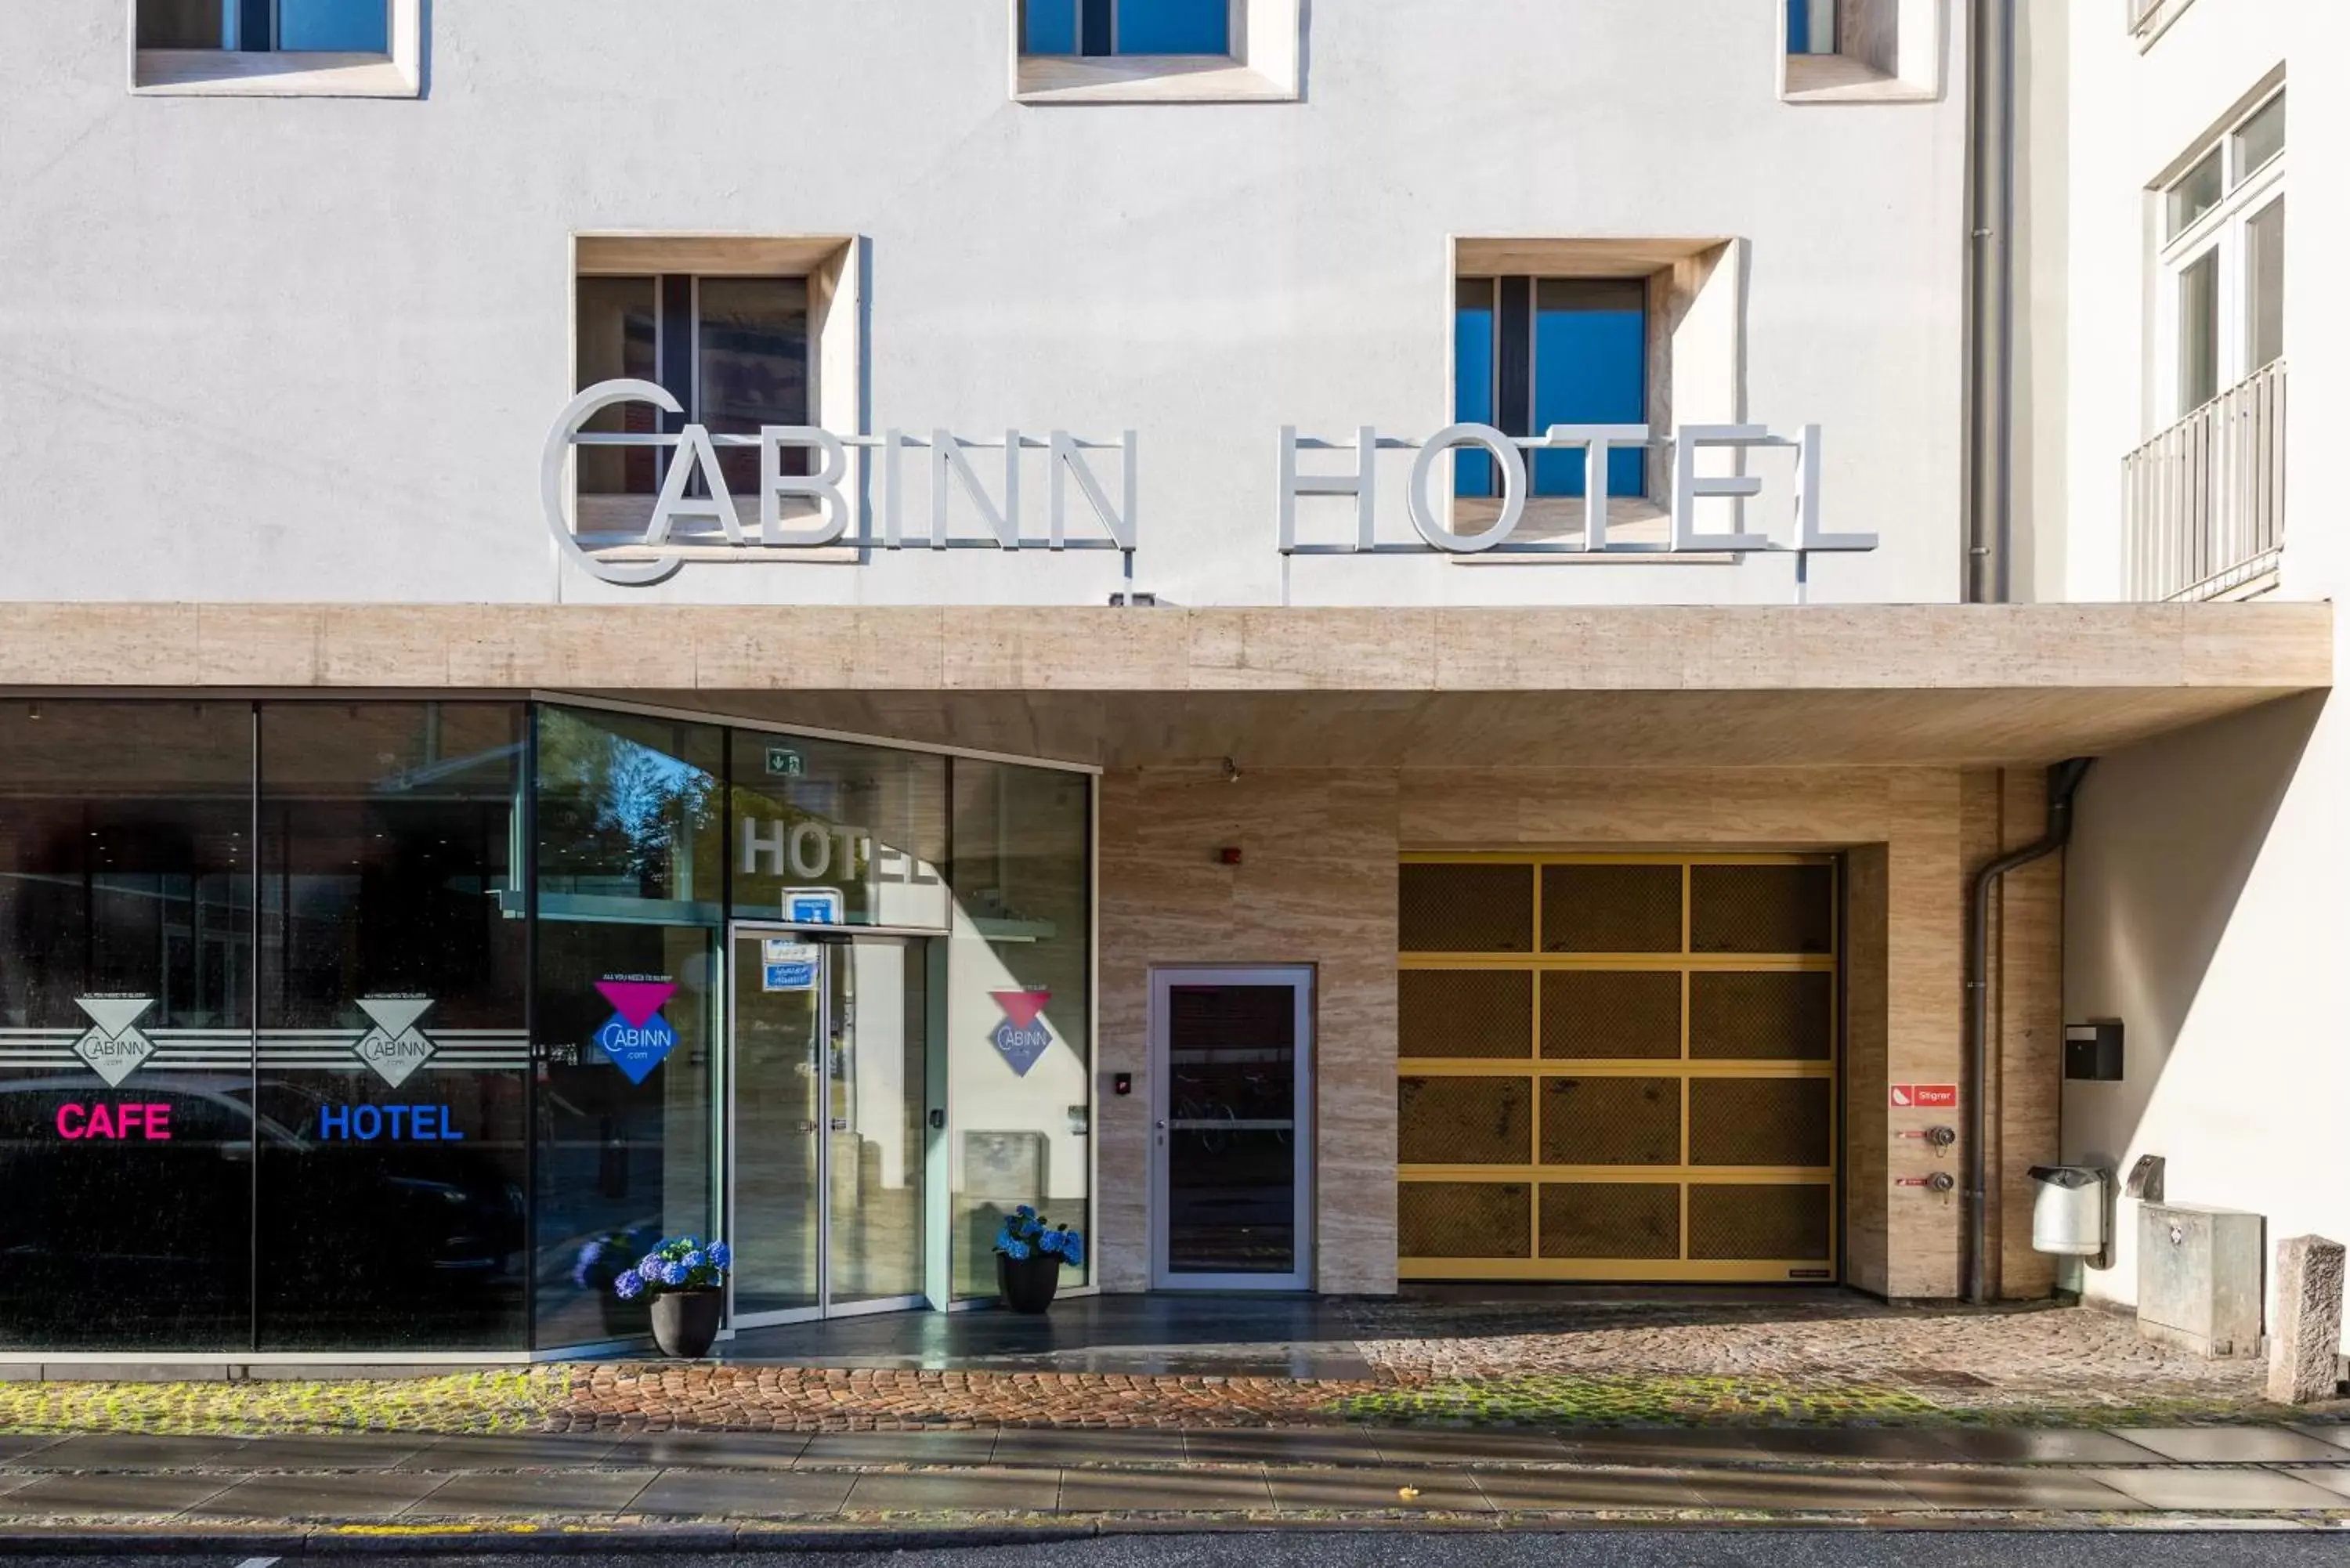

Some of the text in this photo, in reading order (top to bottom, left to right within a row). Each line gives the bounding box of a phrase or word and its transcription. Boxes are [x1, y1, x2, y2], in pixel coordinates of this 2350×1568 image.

[540, 378, 1879, 586] CABINN HOTEL
[742, 817, 939, 885] HOTEL
[83, 1036, 143, 1059] CABINN
[365, 1036, 425, 1060] CABINN
[602, 1022, 671, 1052] CABINN
[997, 1025, 1047, 1050] CABINN
[56, 1104, 172, 1140] CAFE
[321, 1105, 465, 1140] HOTEL
